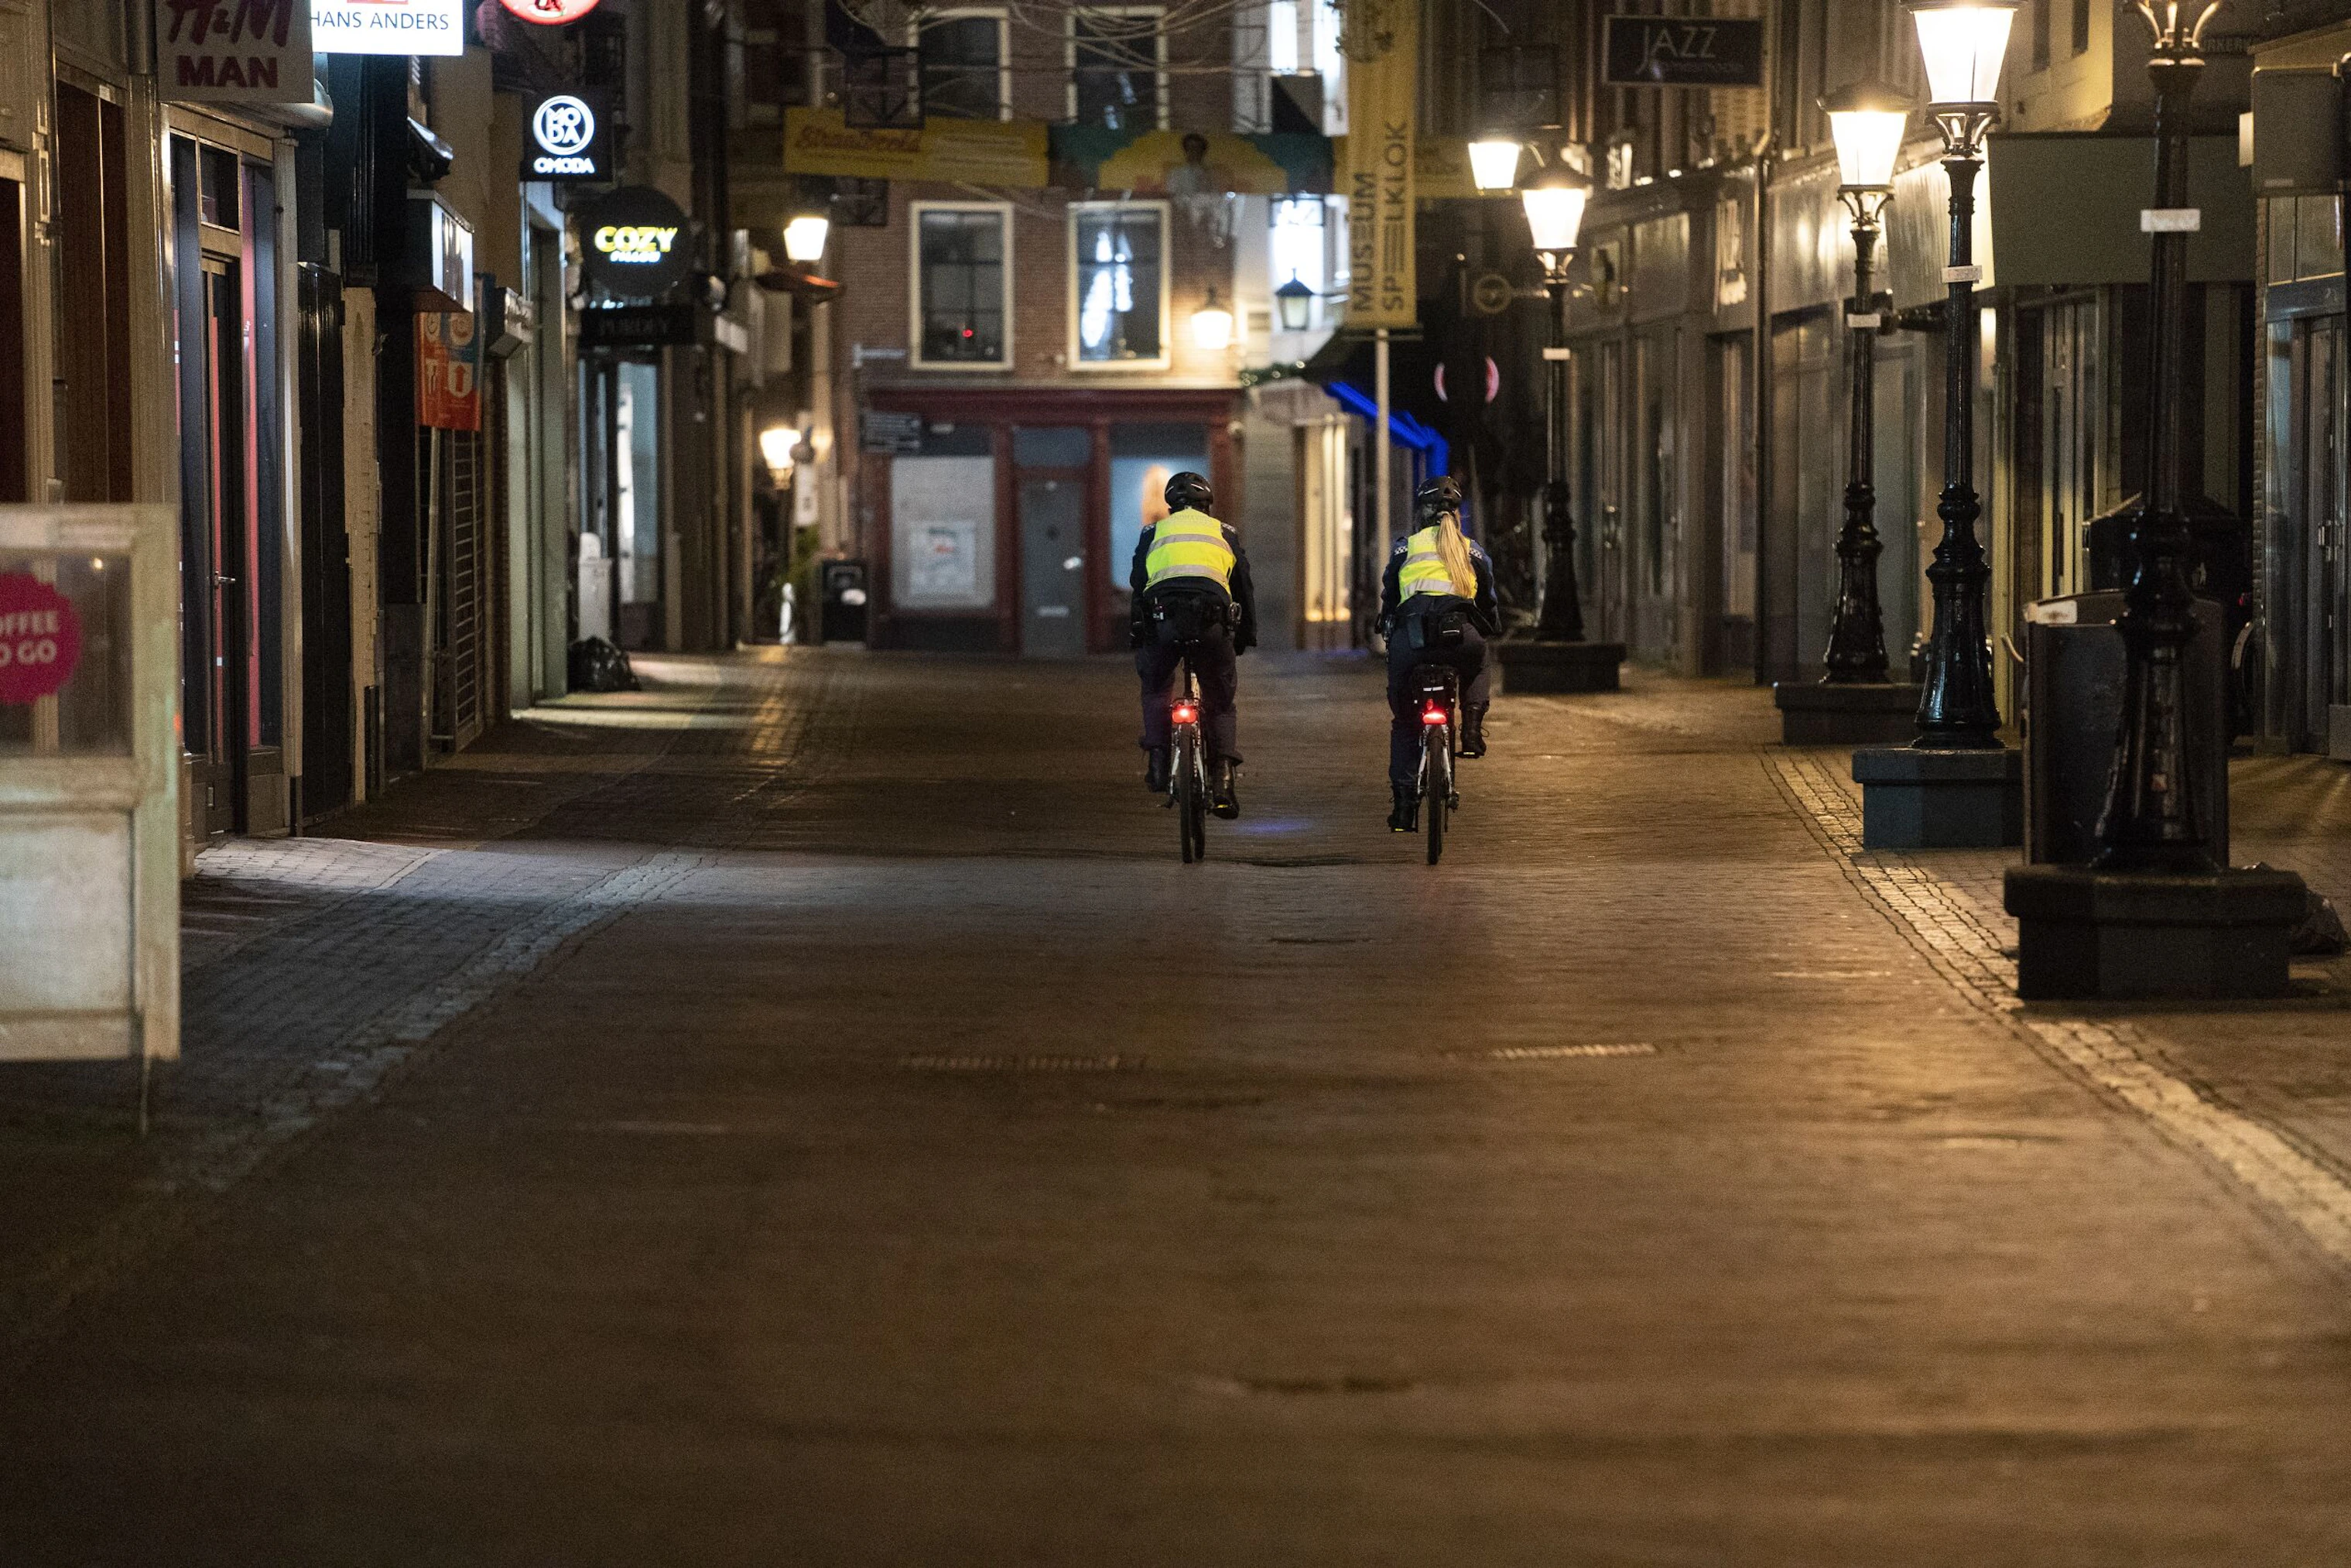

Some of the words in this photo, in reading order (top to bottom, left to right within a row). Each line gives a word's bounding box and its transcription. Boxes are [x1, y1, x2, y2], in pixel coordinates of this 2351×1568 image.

[310, 11, 361, 28] HANS
[370, 12, 449, 30] ANDERS
[1636, 26, 1716, 74] JAZZ
[176, 55, 279, 88] MAN
[534, 157, 594, 174] OMODA
[594, 226, 678, 253] COZY
[1352, 172, 1377, 312] MUSEUM
[0, 611, 59, 635] FFEE
[0, 641, 12, 668] O
[17, 638, 57, 665] GO
